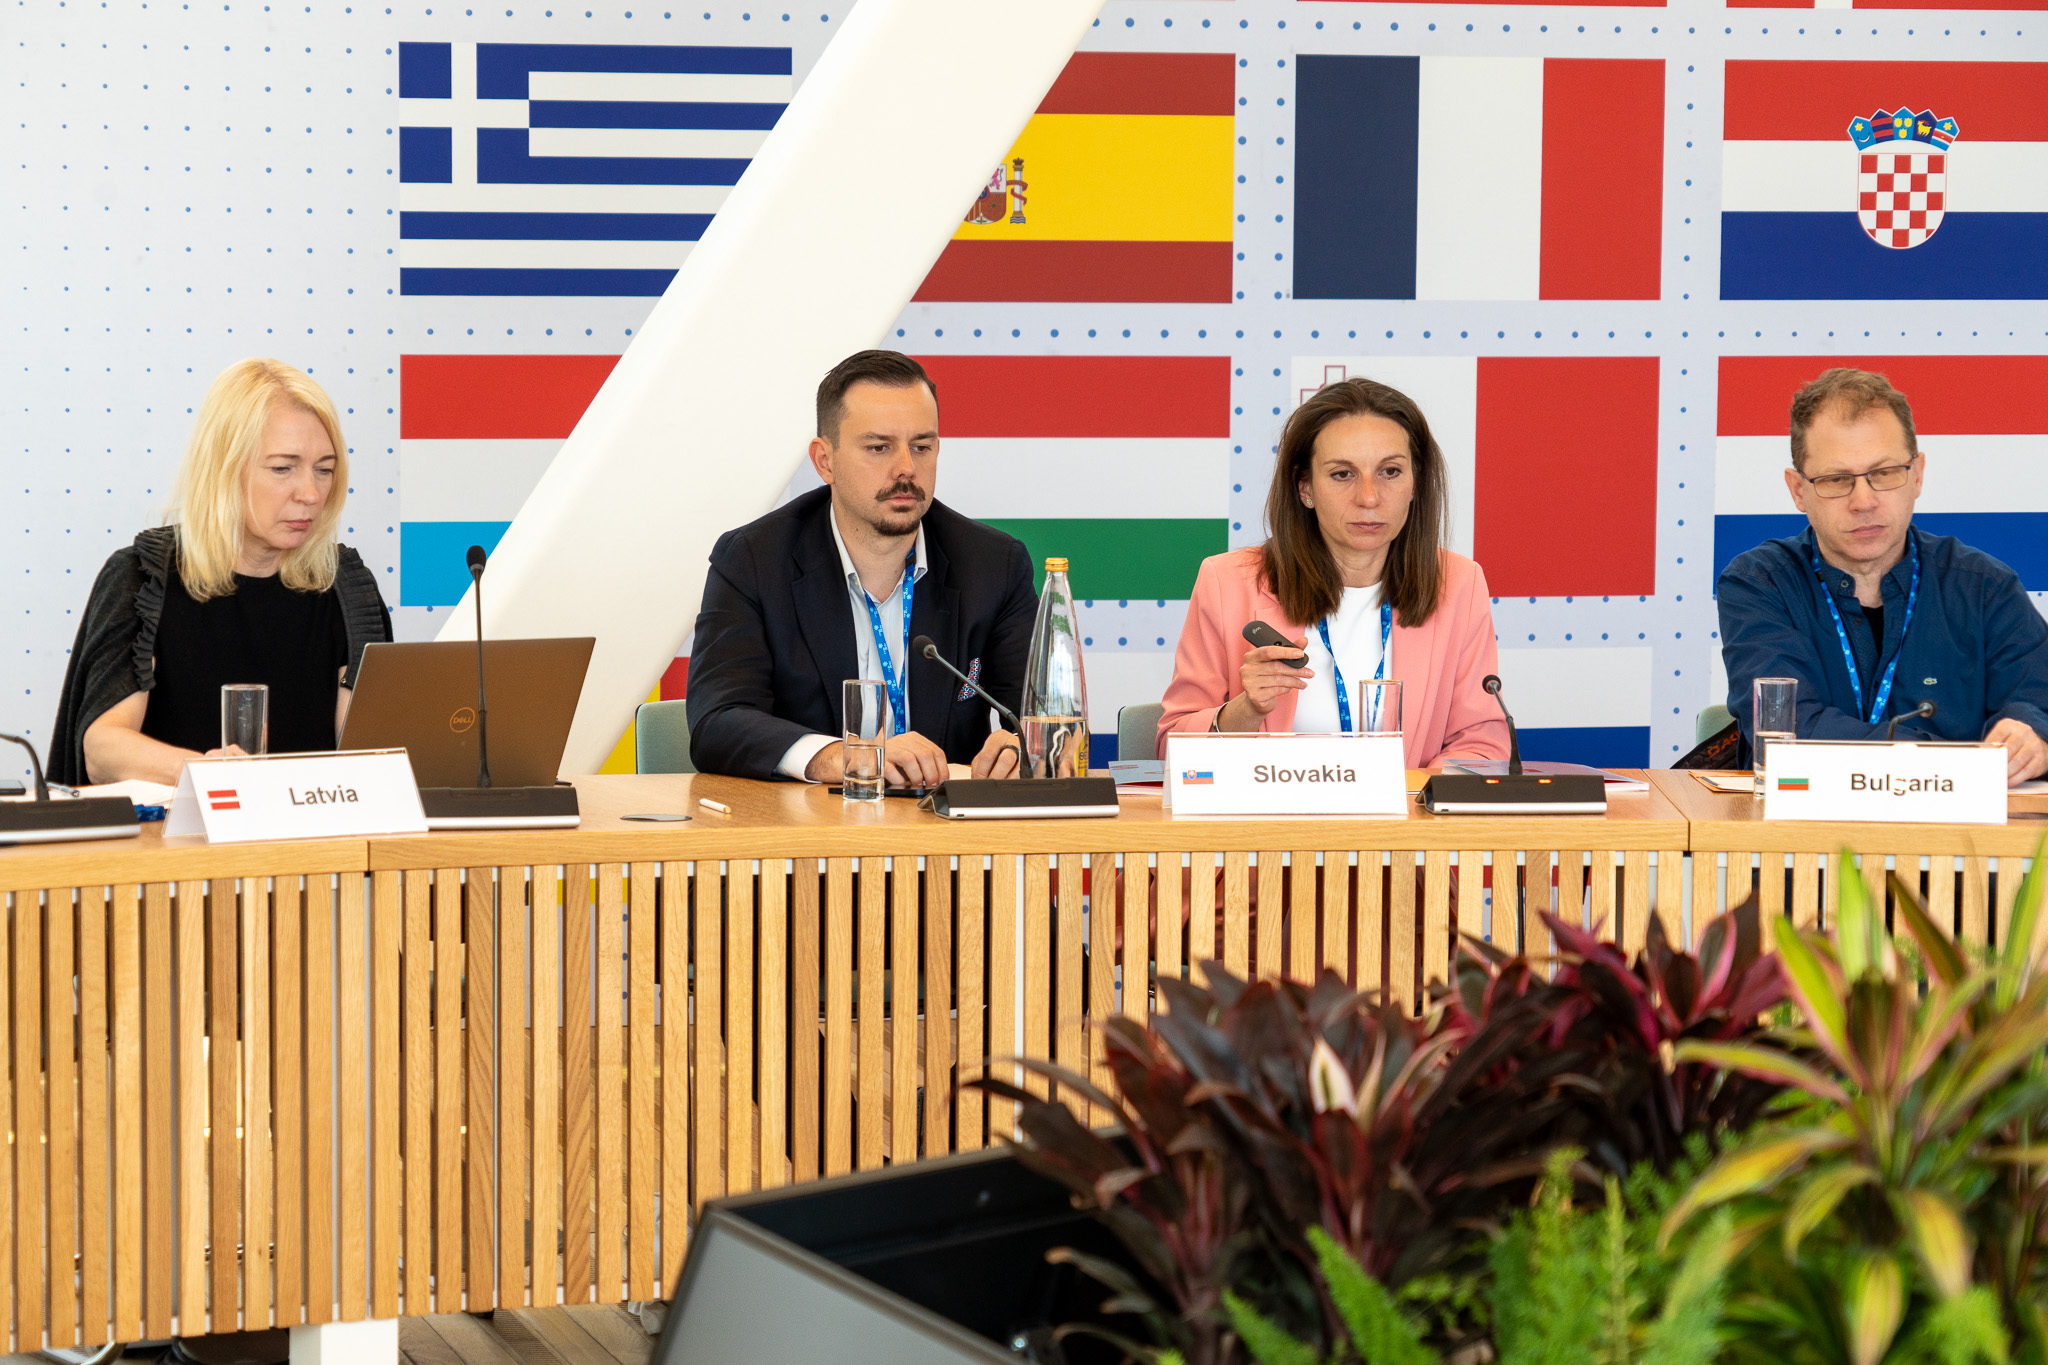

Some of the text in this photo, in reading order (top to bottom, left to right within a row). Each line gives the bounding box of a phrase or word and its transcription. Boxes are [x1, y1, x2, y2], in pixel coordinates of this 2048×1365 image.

[453, 715, 472, 725] DELL
[1254, 764, 1356, 783] Slovakia
[289, 784, 358, 806] Latvia
